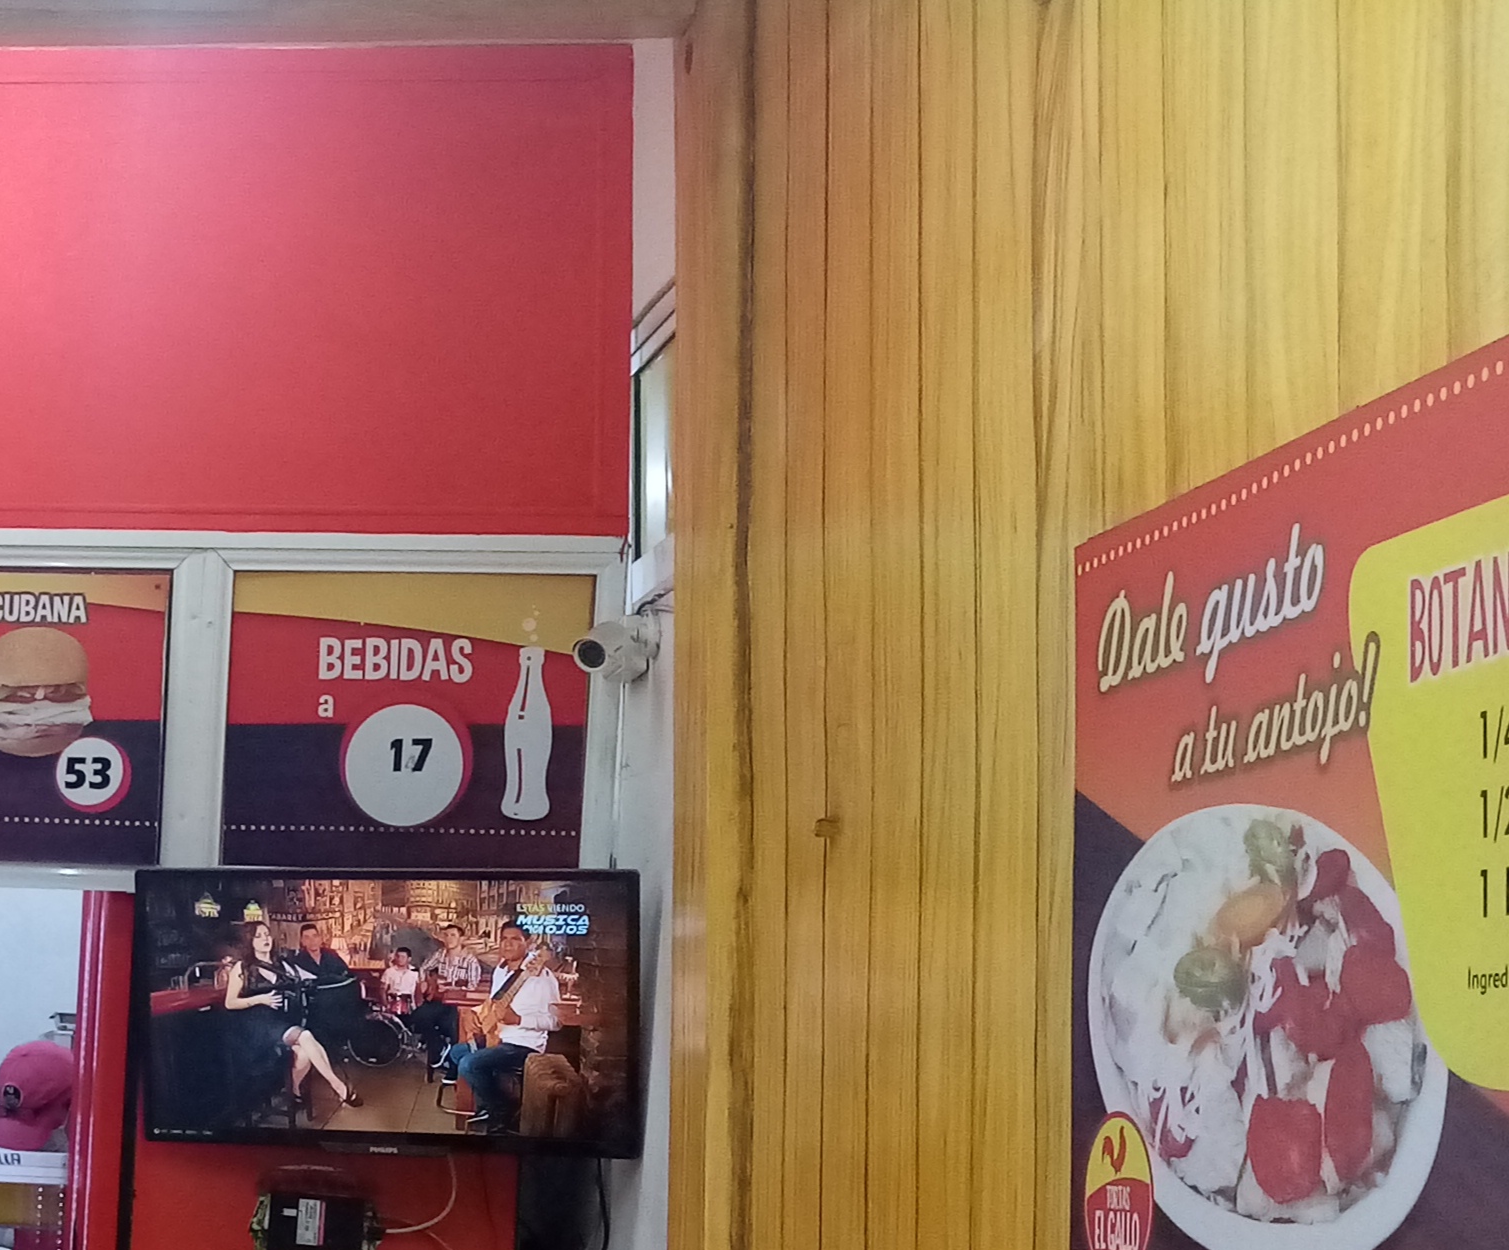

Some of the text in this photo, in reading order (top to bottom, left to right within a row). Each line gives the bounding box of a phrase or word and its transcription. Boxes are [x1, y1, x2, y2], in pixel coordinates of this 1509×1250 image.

[1098, 522, 1325, 692] Dale gusto
[317, 636, 474, 684] BEBIDAS
[317, 693, 334, 718] a
[1171, 633, 1380, 783] a tu antojo!
[389, 737, 433, 773] 17
[1479, 706, 1509, 764] 1/
[63, 757, 112, 789] 53
[1094, 1209, 1107, 1250] EL
